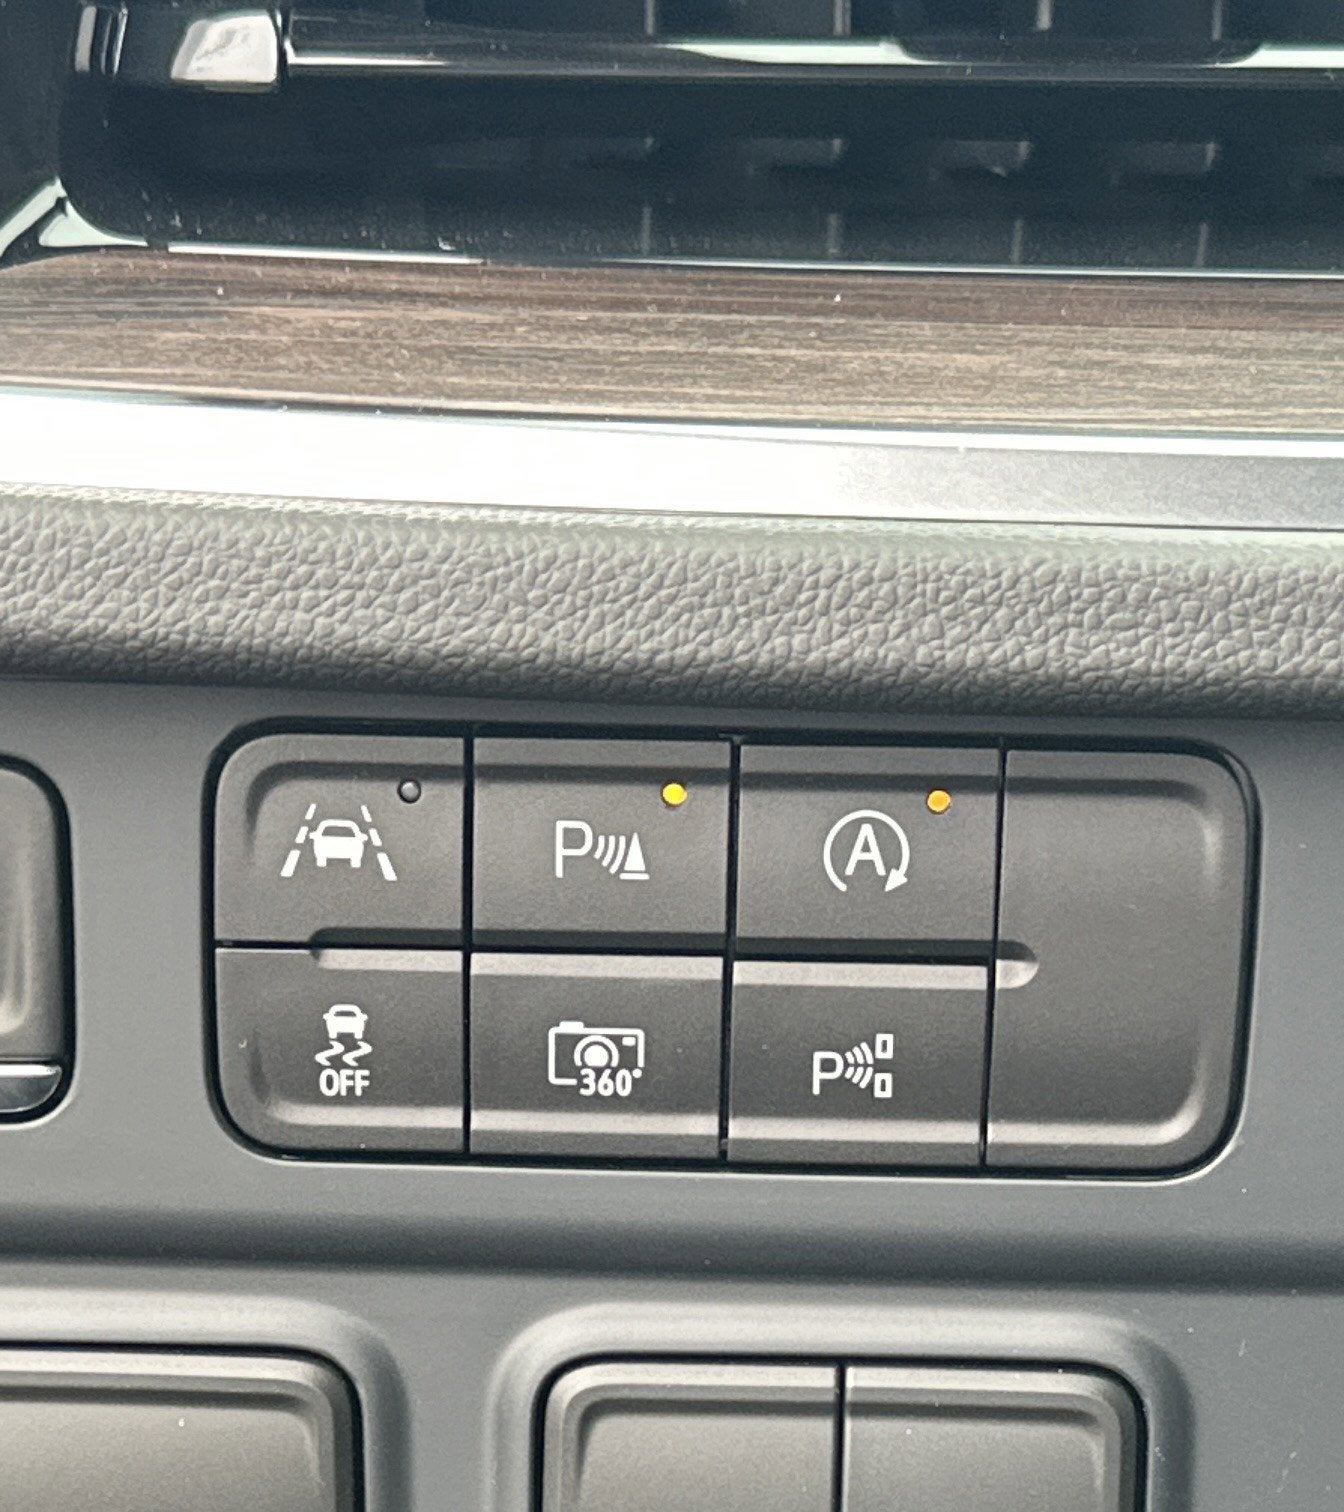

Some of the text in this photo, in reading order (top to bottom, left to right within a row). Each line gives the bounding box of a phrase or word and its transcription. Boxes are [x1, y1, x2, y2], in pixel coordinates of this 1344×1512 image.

[555, 820, 593, 879] P
[844, 823, 887, 876] A
[318, 1068, 371, 1097] OFF
[812, 1050, 844, 1096] P
